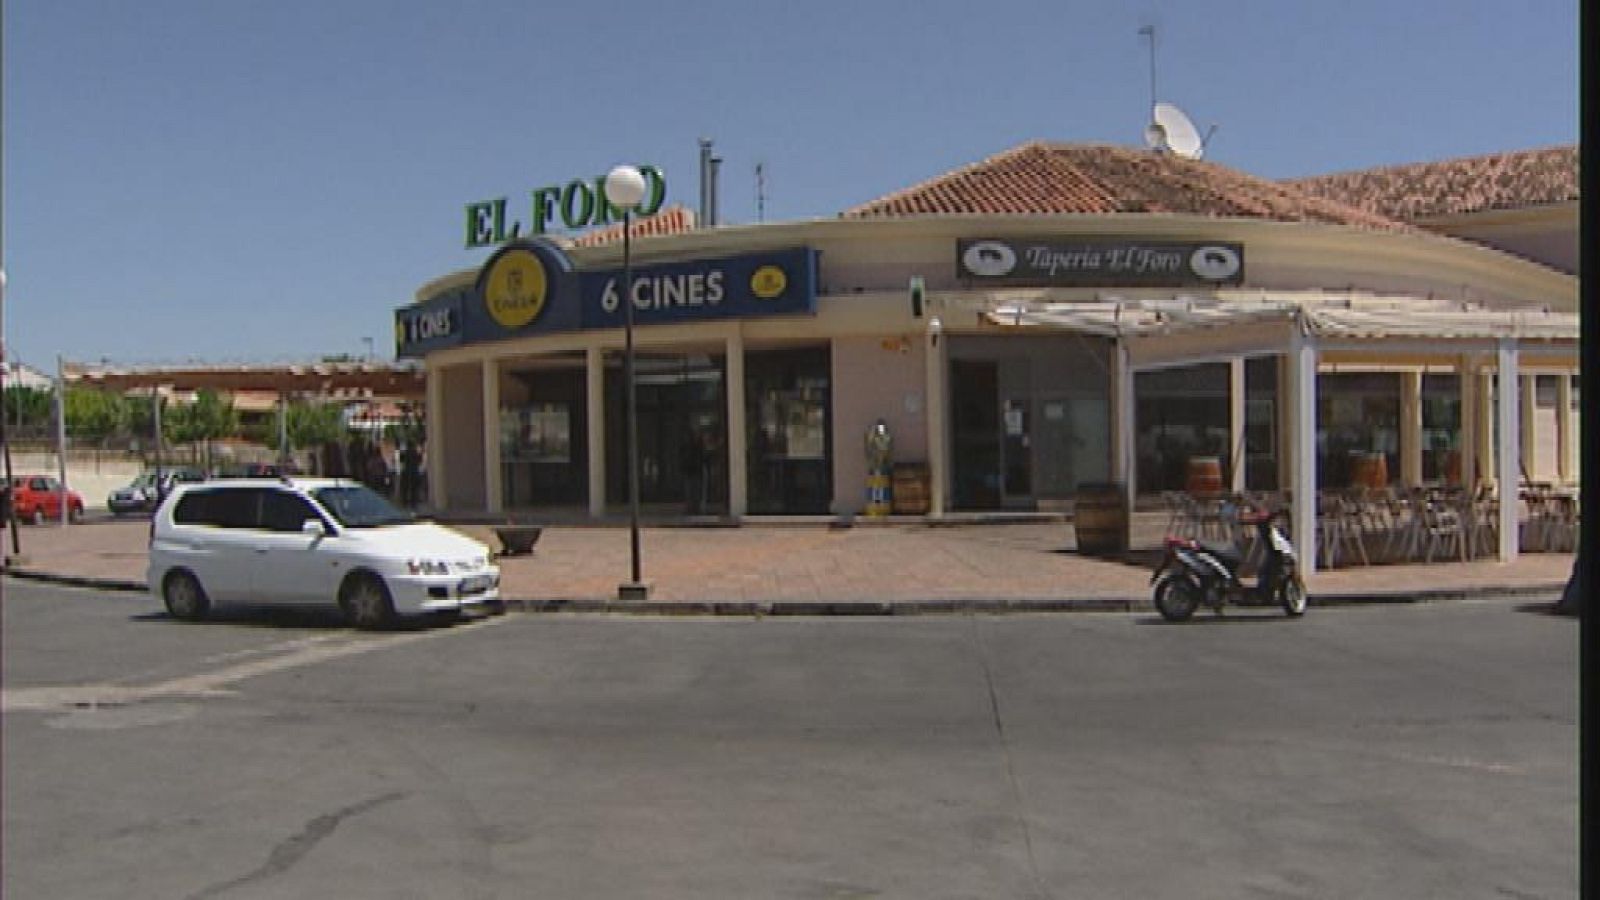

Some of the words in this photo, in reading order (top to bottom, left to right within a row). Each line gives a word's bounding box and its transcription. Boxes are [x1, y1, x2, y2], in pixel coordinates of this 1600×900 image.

[465, 198, 520, 247] EL
[1105, 246, 1137, 272] El
[1136, 249, 1182, 273] Foro
[601, 276, 620, 313] 6
[631, 271, 725, 311] CINES
